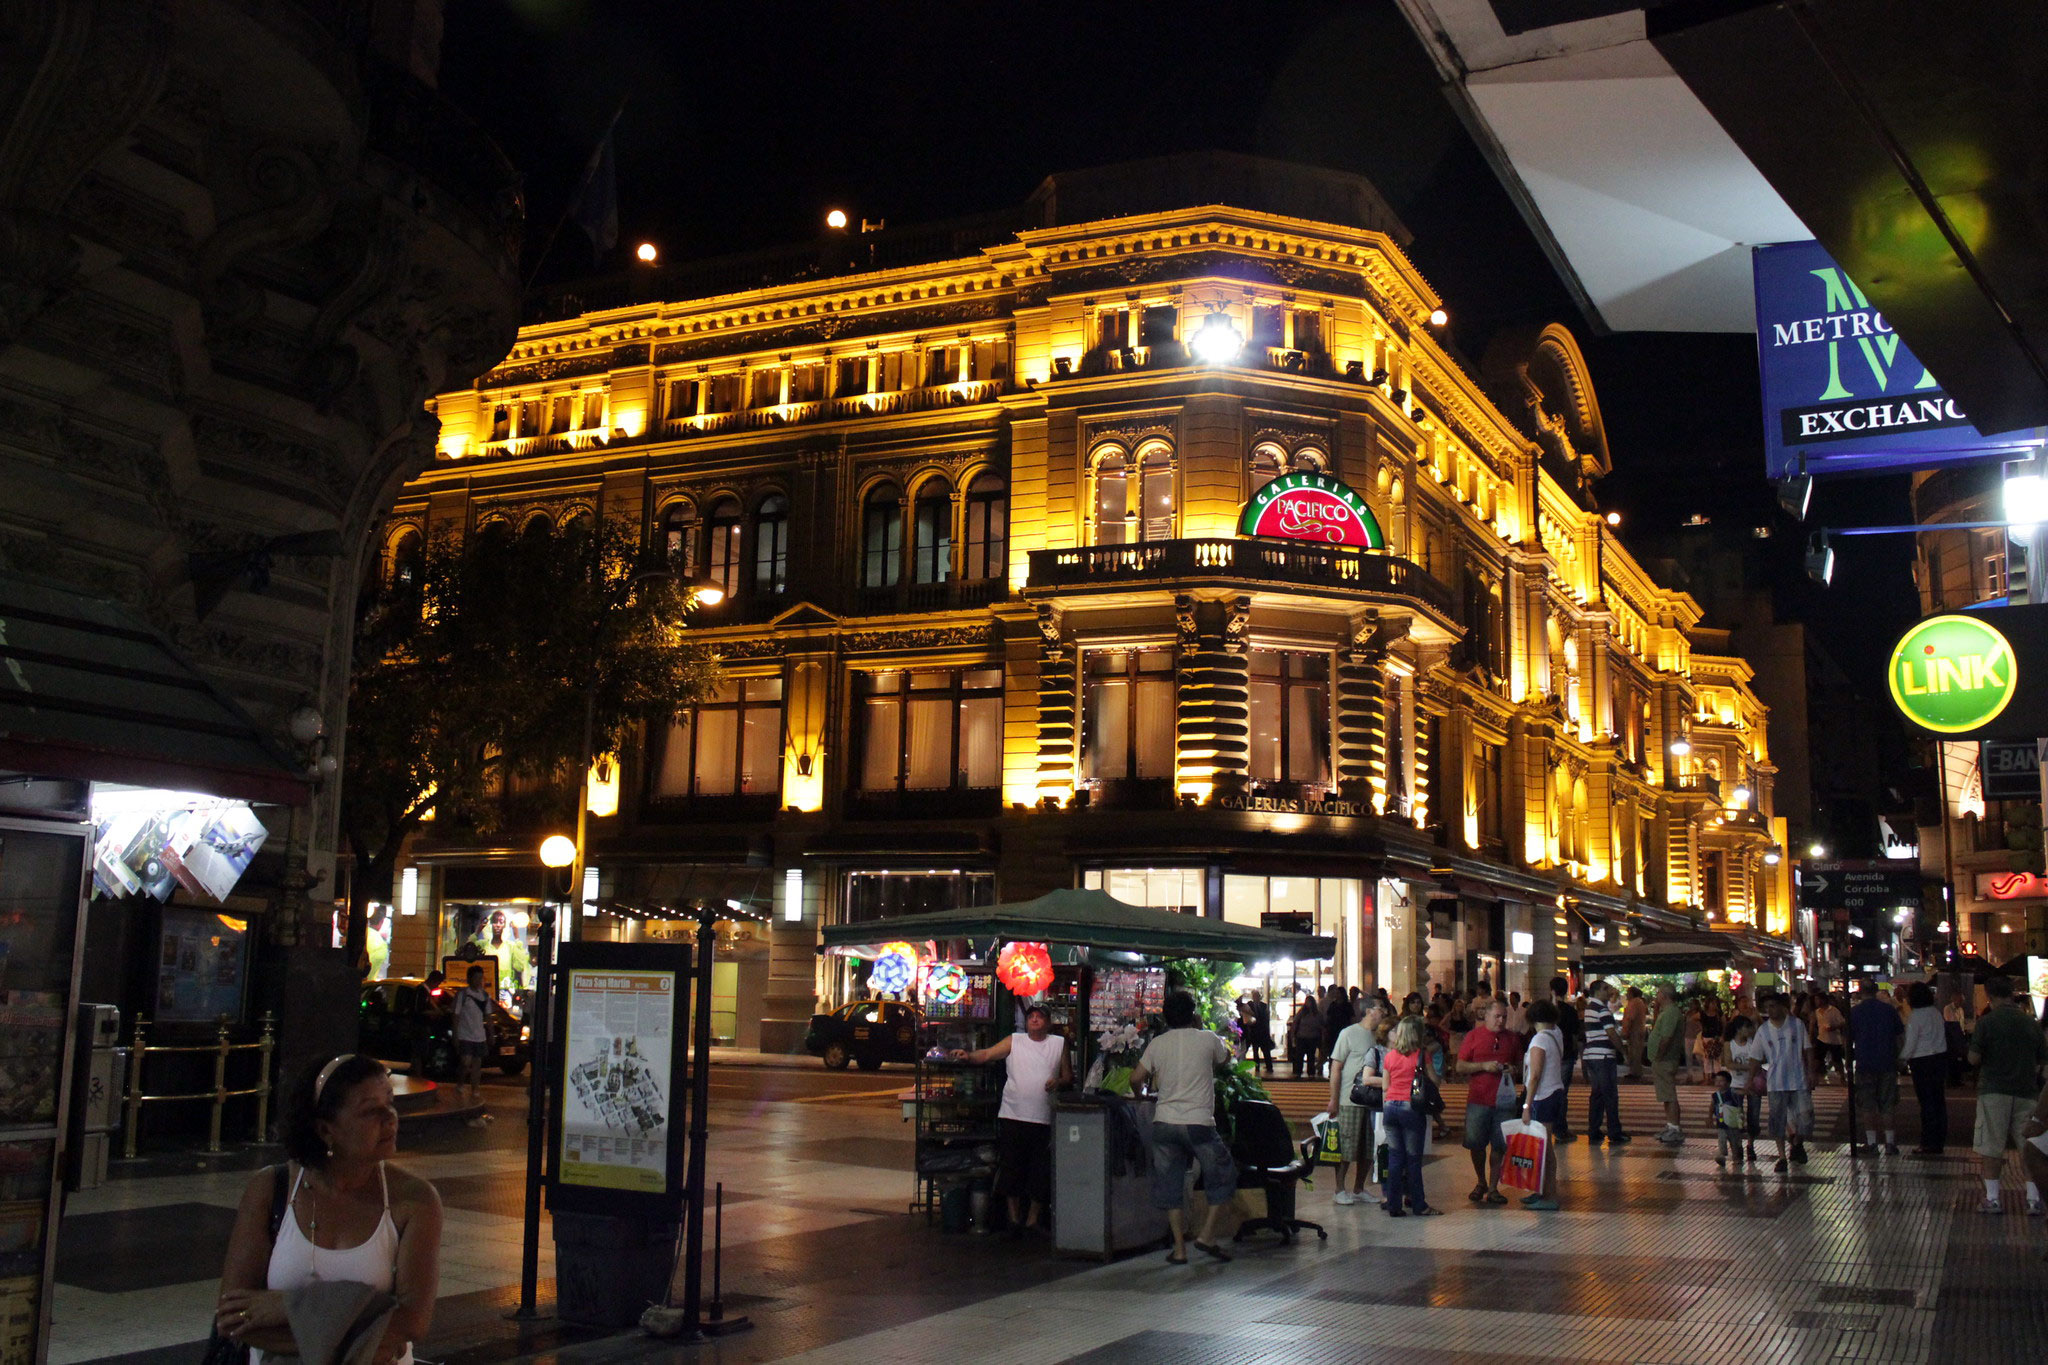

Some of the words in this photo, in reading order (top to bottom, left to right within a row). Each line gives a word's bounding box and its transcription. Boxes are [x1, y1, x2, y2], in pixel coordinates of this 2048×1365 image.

[1256, 475, 1368, 516] GALERIAS
[1277, 498, 1350, 524] PACIFICO
[1221, 795, 1298, 812] GALERIAS
[1303, 799, 1373, 817] PACIFICO
[1811, 862, 1841, 871] Claro
[1844, 873, 1885, 881] Avenida
[1844, 898, 1864, 906] 600
[1900, 898, 1919, 906] 700
[593, 977, 606, 988] San
